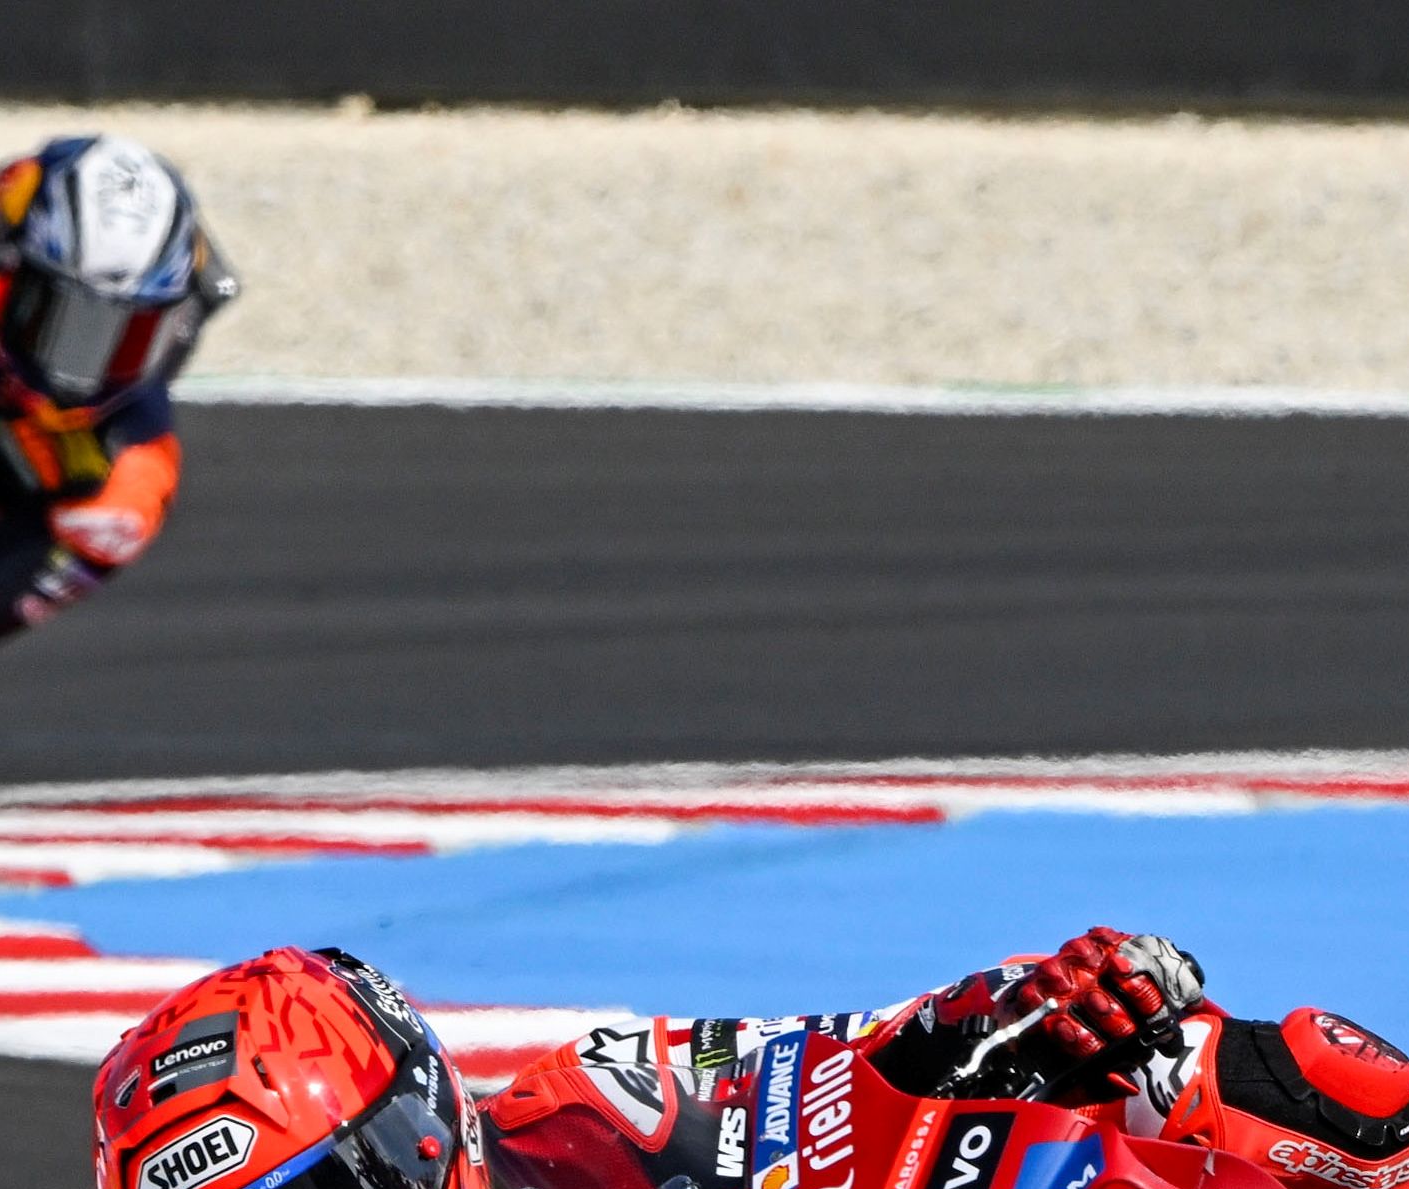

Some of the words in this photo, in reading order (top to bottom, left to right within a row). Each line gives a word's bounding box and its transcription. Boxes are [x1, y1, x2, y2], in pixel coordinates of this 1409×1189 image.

[154, 1039, 228, 1071] Lenovo
[764, 1042, 799, 1144] ADVANCE
[715, 1107, 747, 1178] WRS
[802, 1049, 855, 1171] riello
